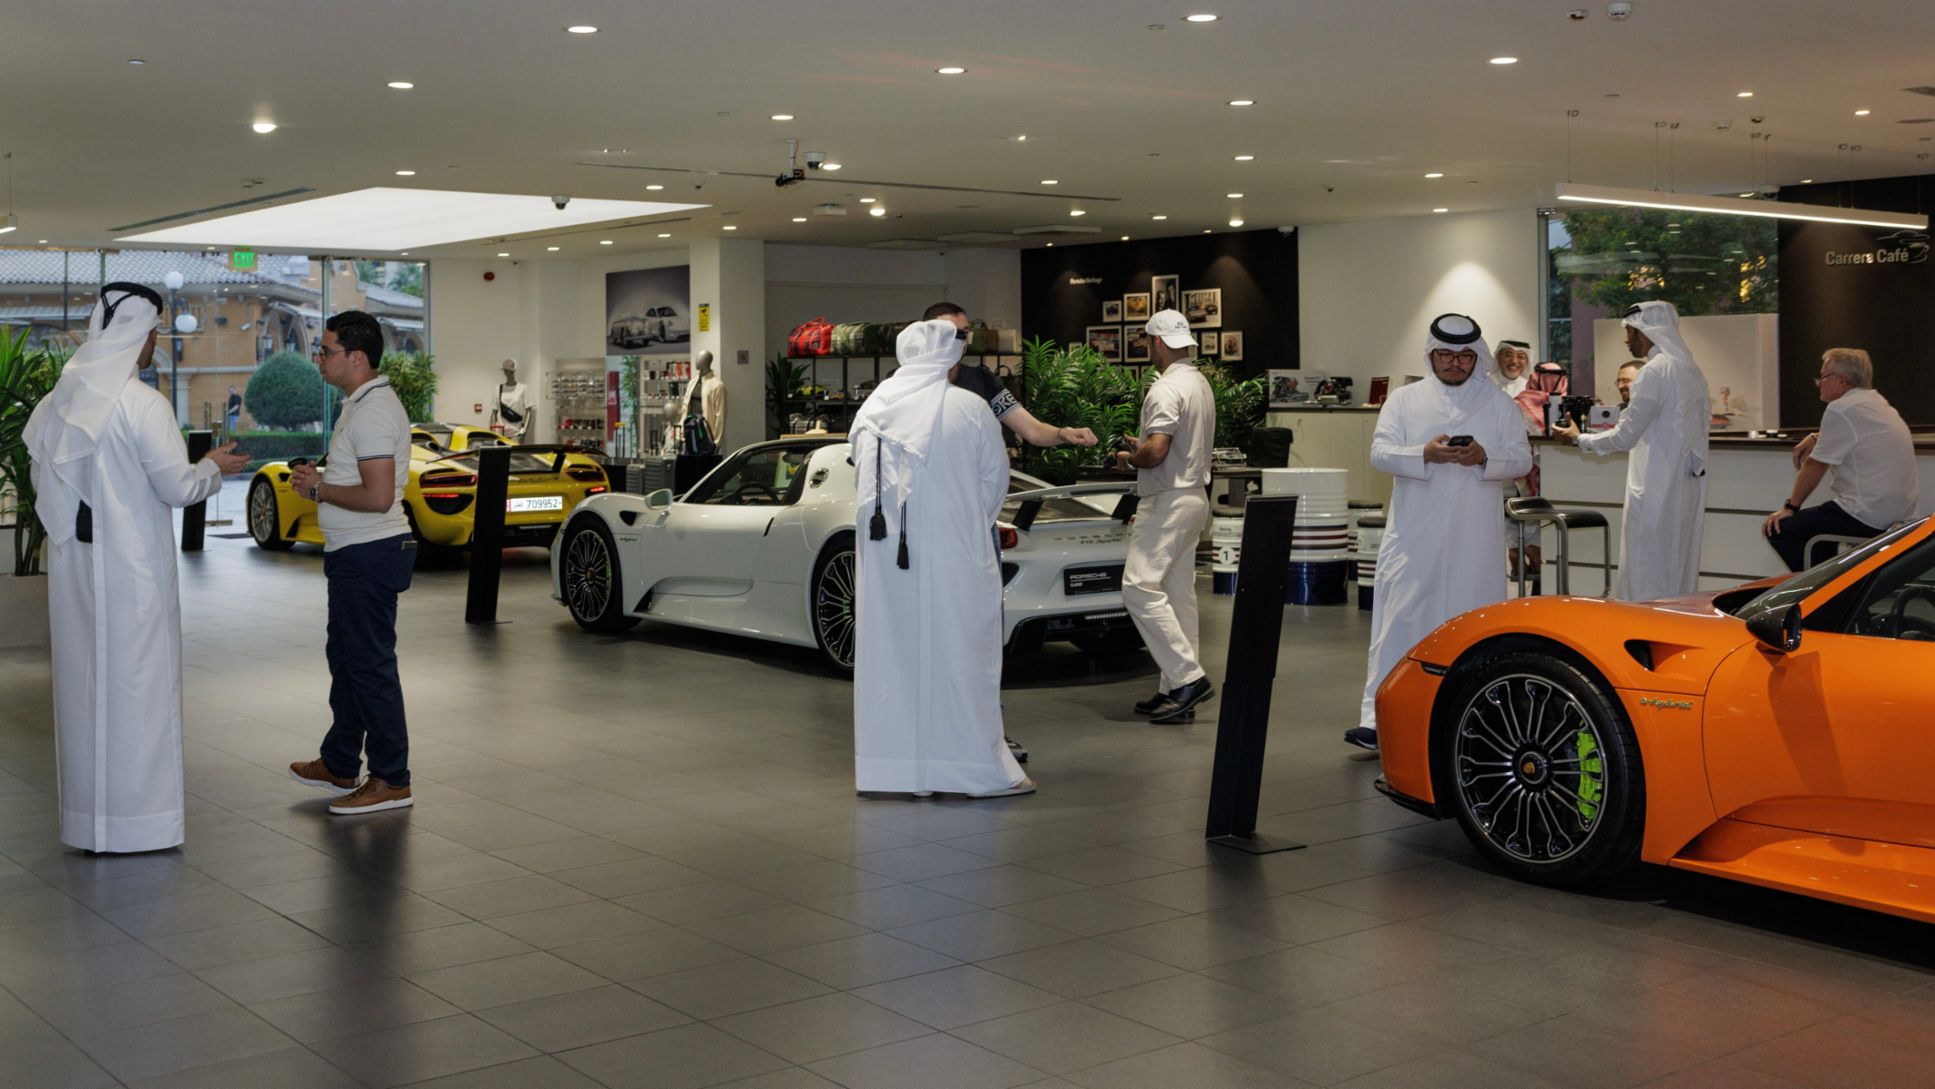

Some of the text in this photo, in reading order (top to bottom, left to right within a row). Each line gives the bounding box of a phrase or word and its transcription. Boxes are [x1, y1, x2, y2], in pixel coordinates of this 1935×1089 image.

[233, 251, 255, 268] EXIT
[1825, 247, 1909, 265] Carrera Café
[526, 499, 559, 509] 709952
[1222, 550, 1228, 561] 1
